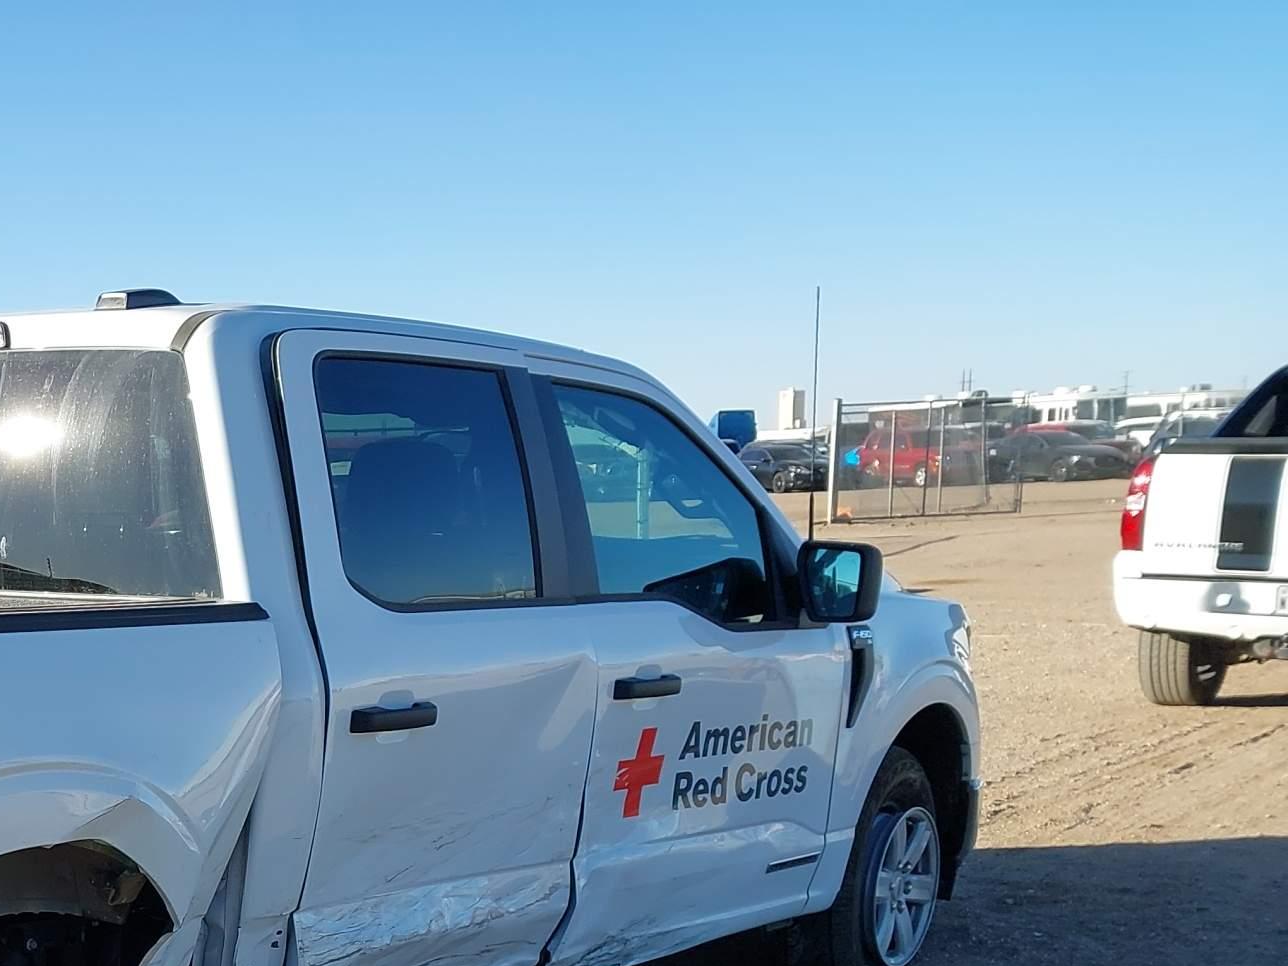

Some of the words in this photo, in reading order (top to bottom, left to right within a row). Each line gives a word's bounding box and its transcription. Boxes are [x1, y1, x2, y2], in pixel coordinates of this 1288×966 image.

[678, 713, 814, 760] American
[672, 766, 729, 811] Red
[735, 762, 809, 802] Cross
